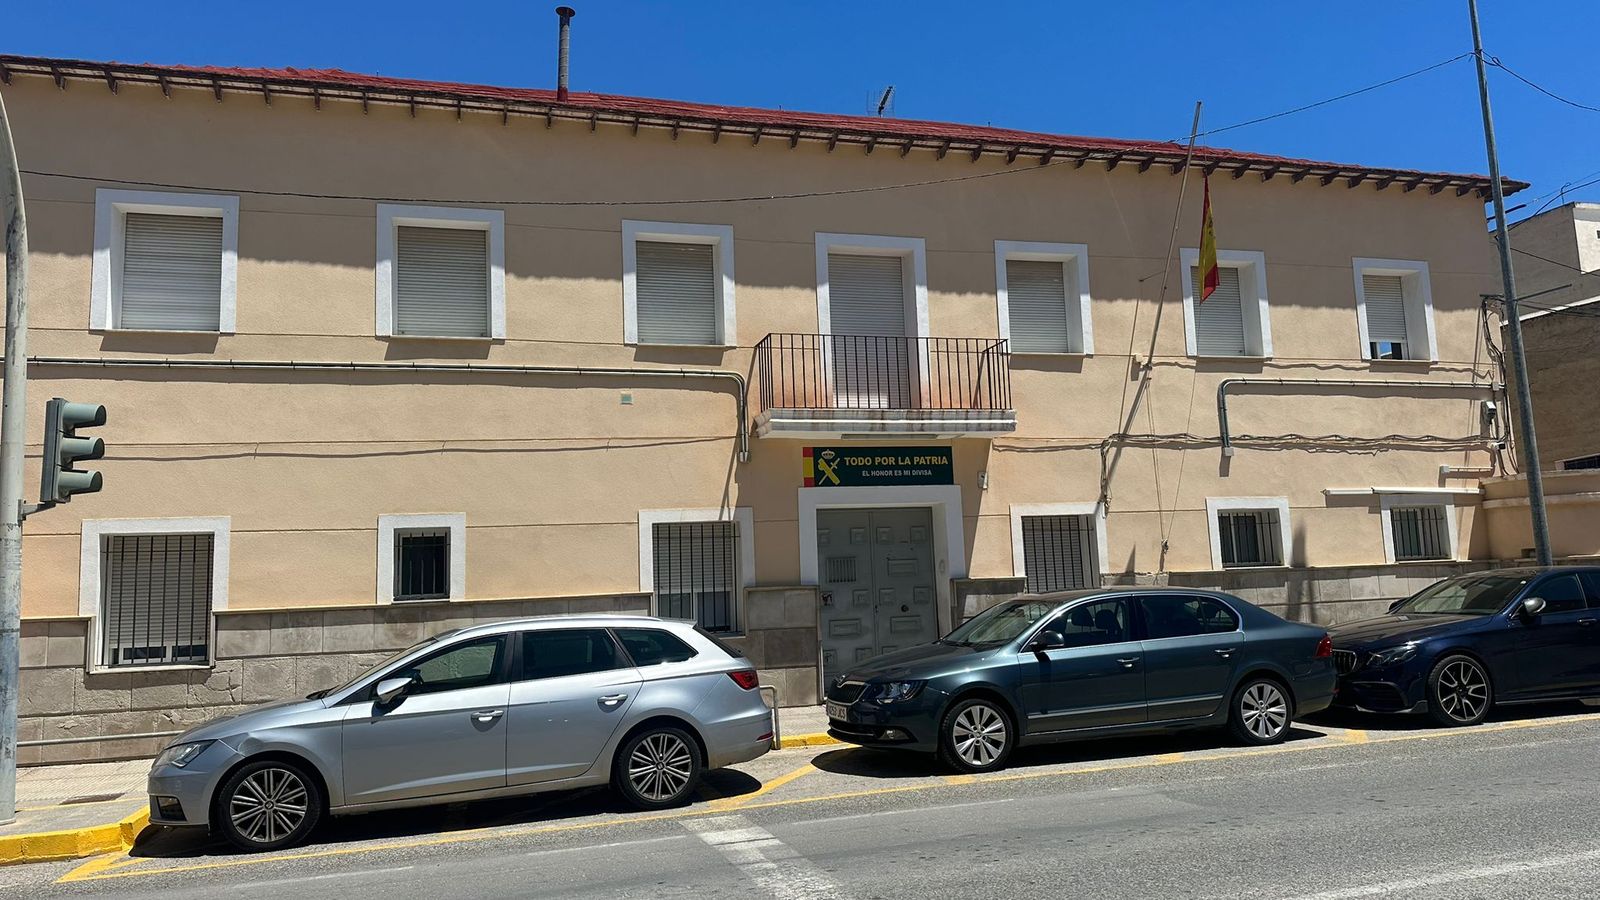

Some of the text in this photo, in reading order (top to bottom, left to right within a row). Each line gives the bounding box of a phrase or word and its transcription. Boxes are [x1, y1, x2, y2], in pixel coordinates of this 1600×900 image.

[844, 456, 948, 466] TODO POR LA PATRIA
[871, 469, 893, 477] HONOR
[894, 469, 902, 477] ES
